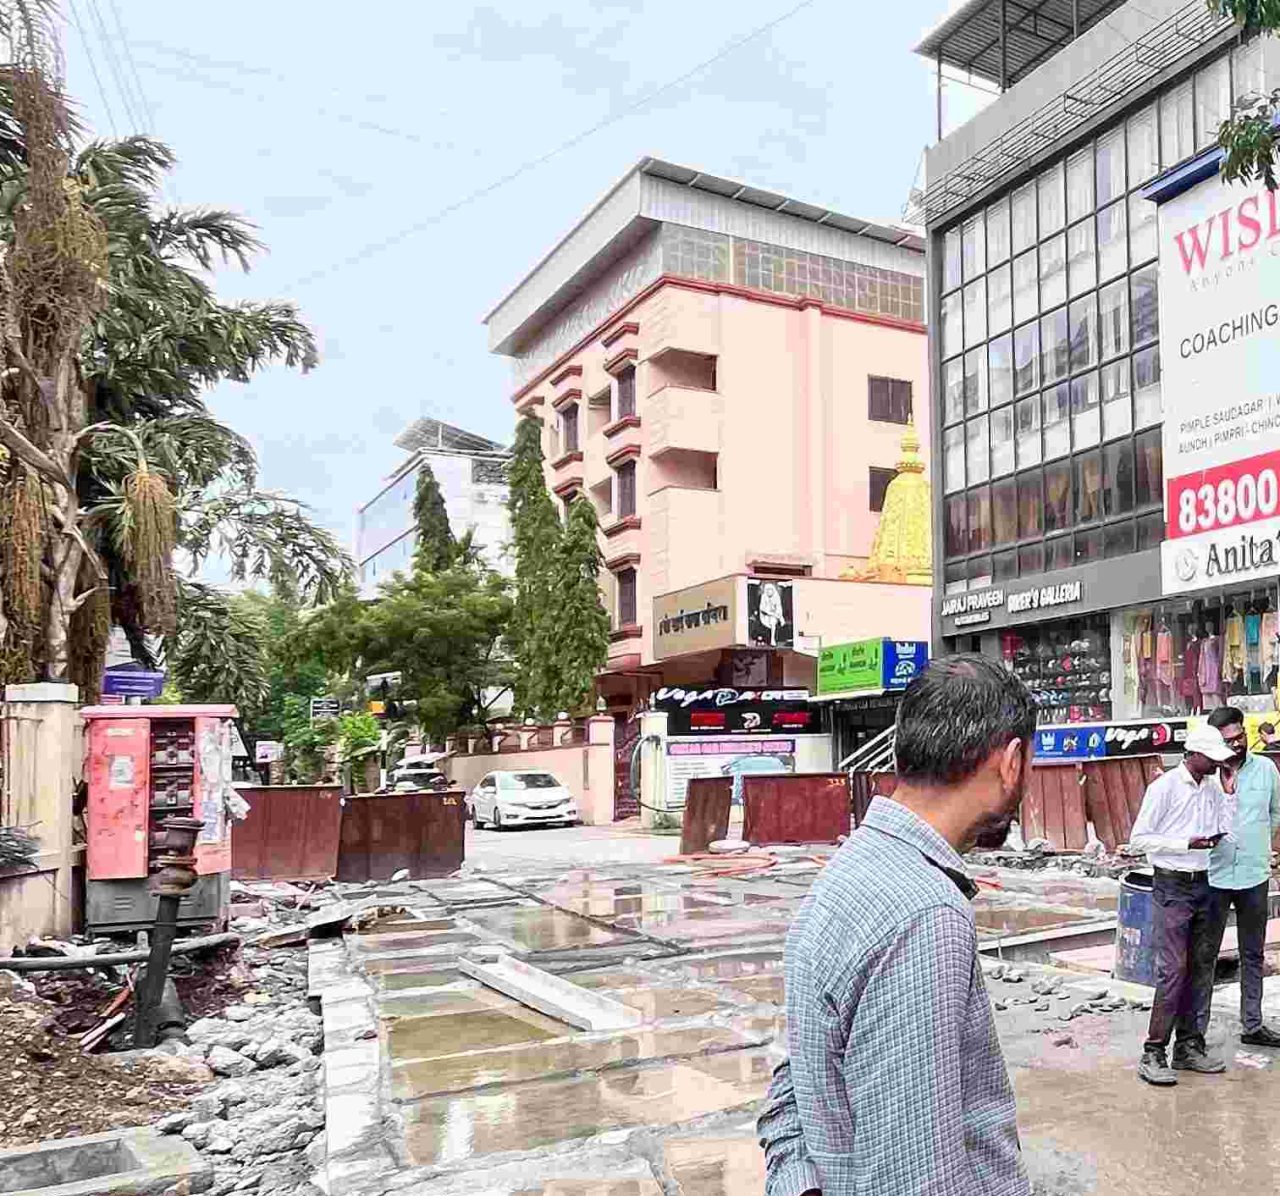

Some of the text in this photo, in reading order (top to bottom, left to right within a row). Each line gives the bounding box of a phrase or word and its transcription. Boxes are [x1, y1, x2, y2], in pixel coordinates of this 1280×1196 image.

[1180, 303, 1279, 359] COACHING
[1180, 415, 1211, 434] PIMPLE
[1212, 398, 1264, 425] SAUDAGAR
[1179, 436, 1208, 454] AUNDH
[1178, 468, 1278, 533] 83800
[1040, 581, 1081, 607] GALLERIA
